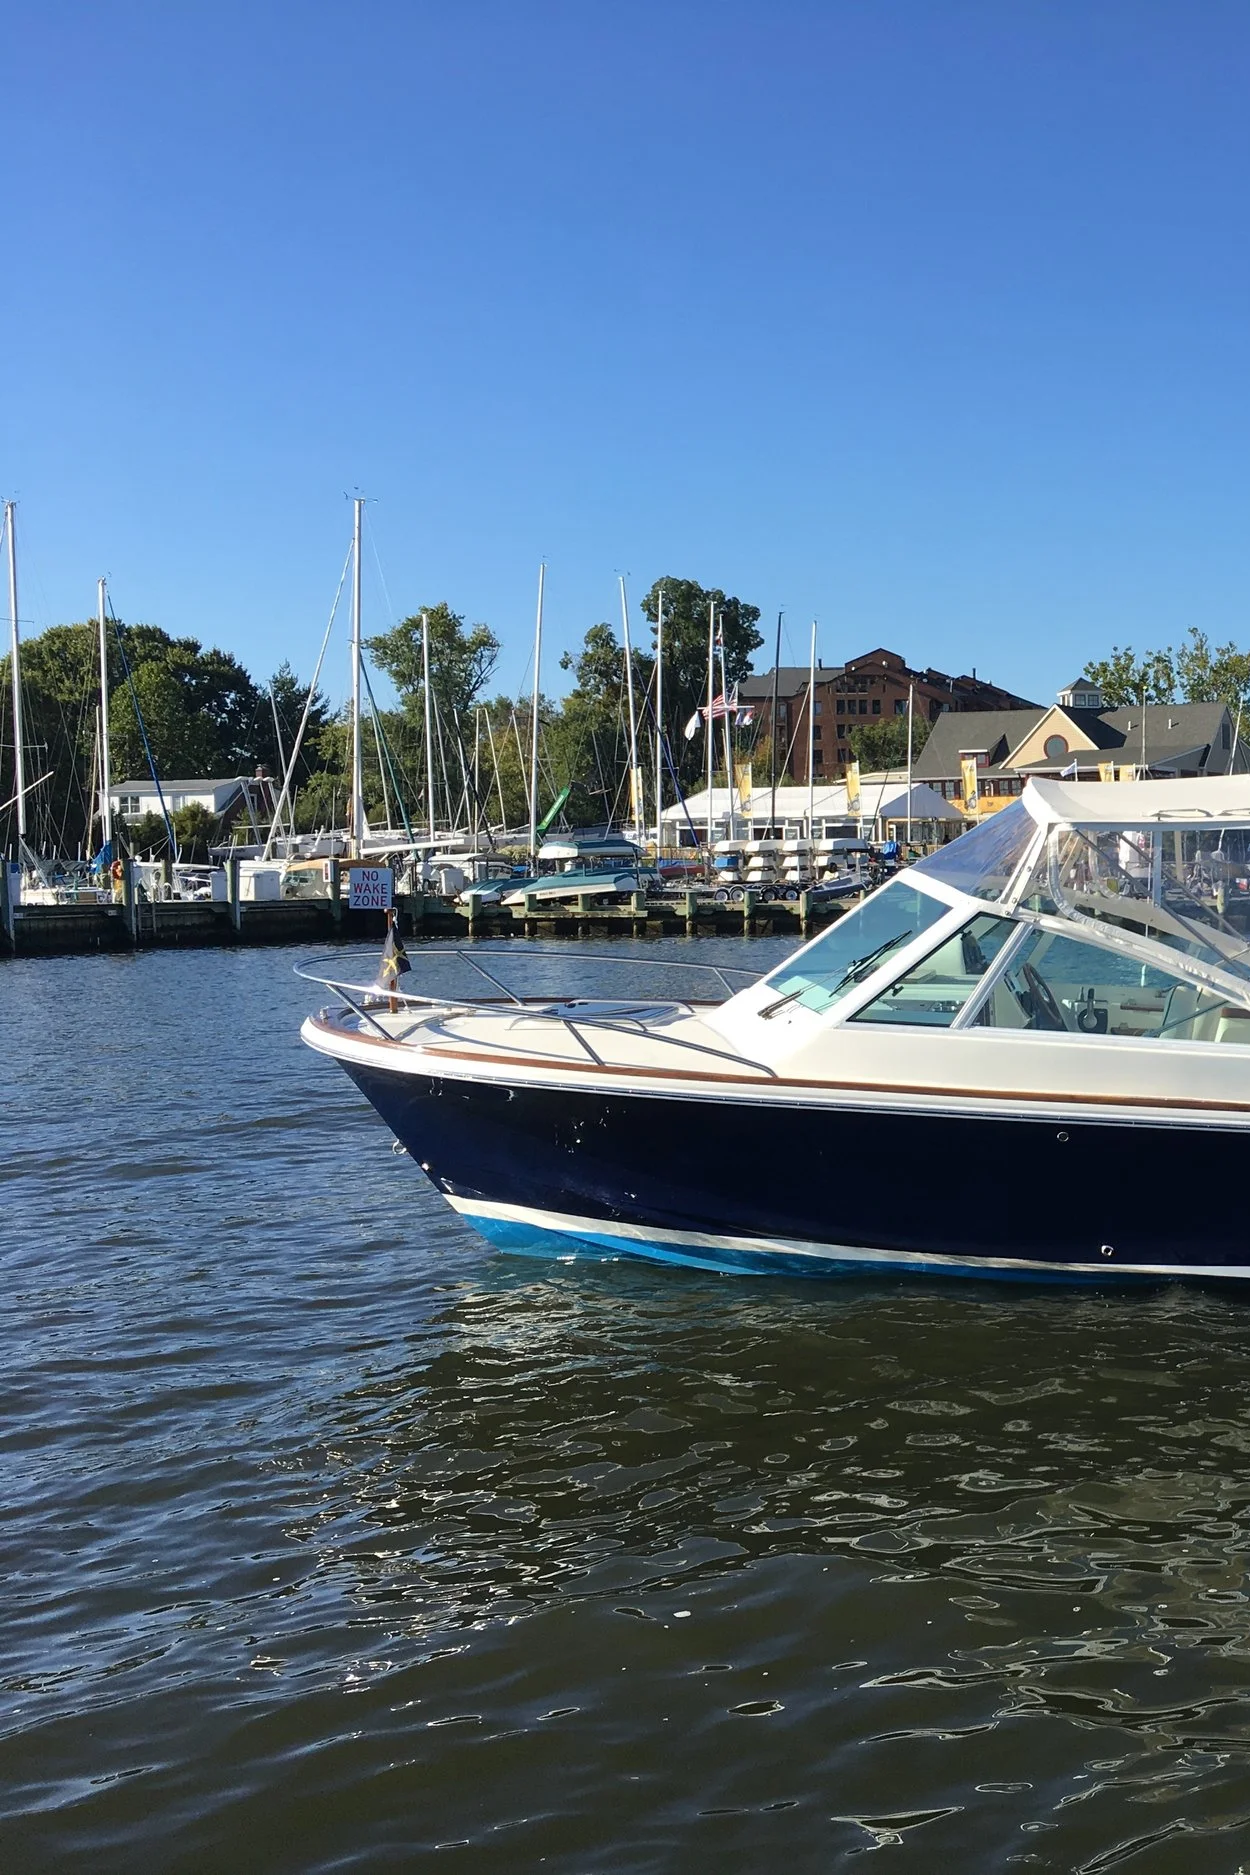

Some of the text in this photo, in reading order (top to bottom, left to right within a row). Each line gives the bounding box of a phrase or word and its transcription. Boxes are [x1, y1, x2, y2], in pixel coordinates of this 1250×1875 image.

[362, 870, 379, 881] NO
[353, 883, 388, 894] WAKE
[353, 895, 388, 906] ZONE
